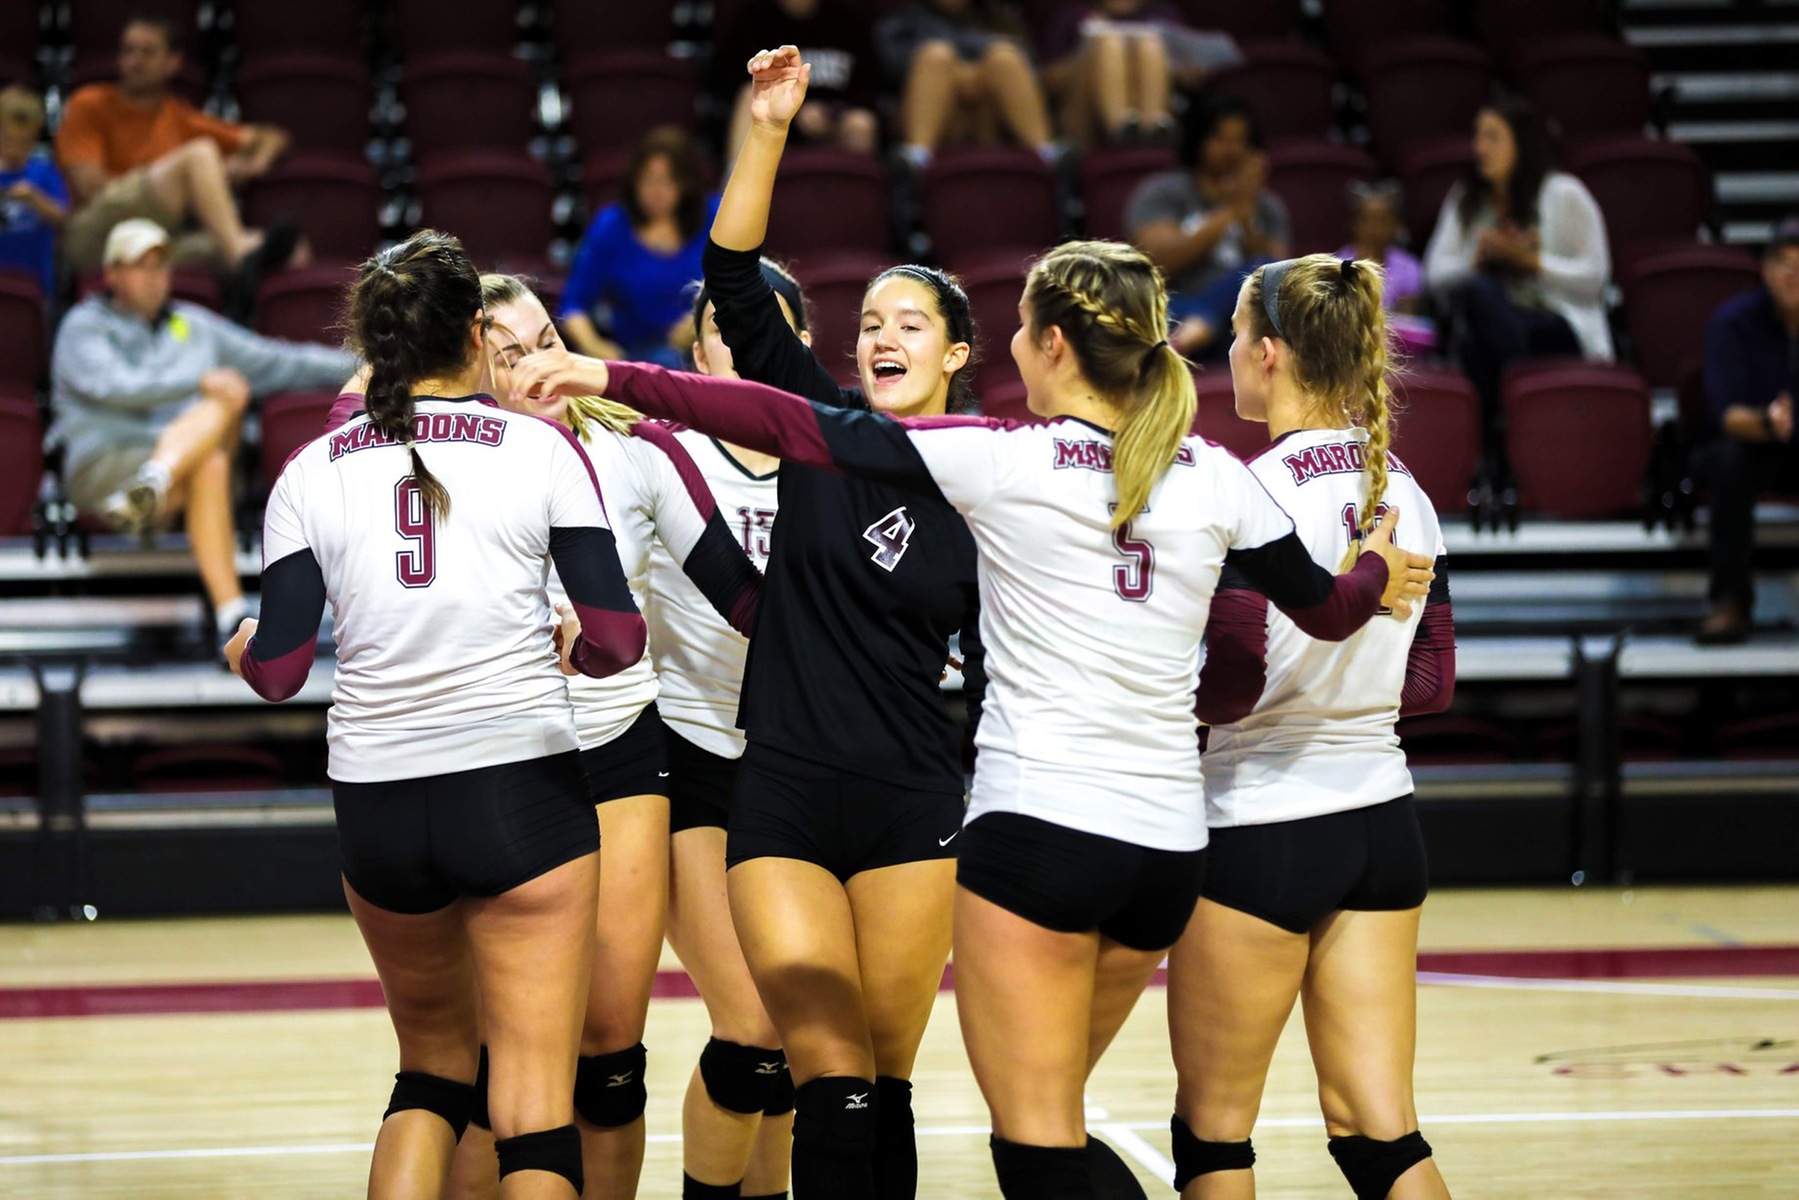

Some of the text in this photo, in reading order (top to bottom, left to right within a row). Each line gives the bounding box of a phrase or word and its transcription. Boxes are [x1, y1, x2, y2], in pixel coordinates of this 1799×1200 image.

[329, 413, 507, 462] MAOONS
[394, 475, 436, 588] 9
[736, 506, 776, 558] 15
[862, 506, 915, 572] 4
[1108, 502, 1155, 602] 5
